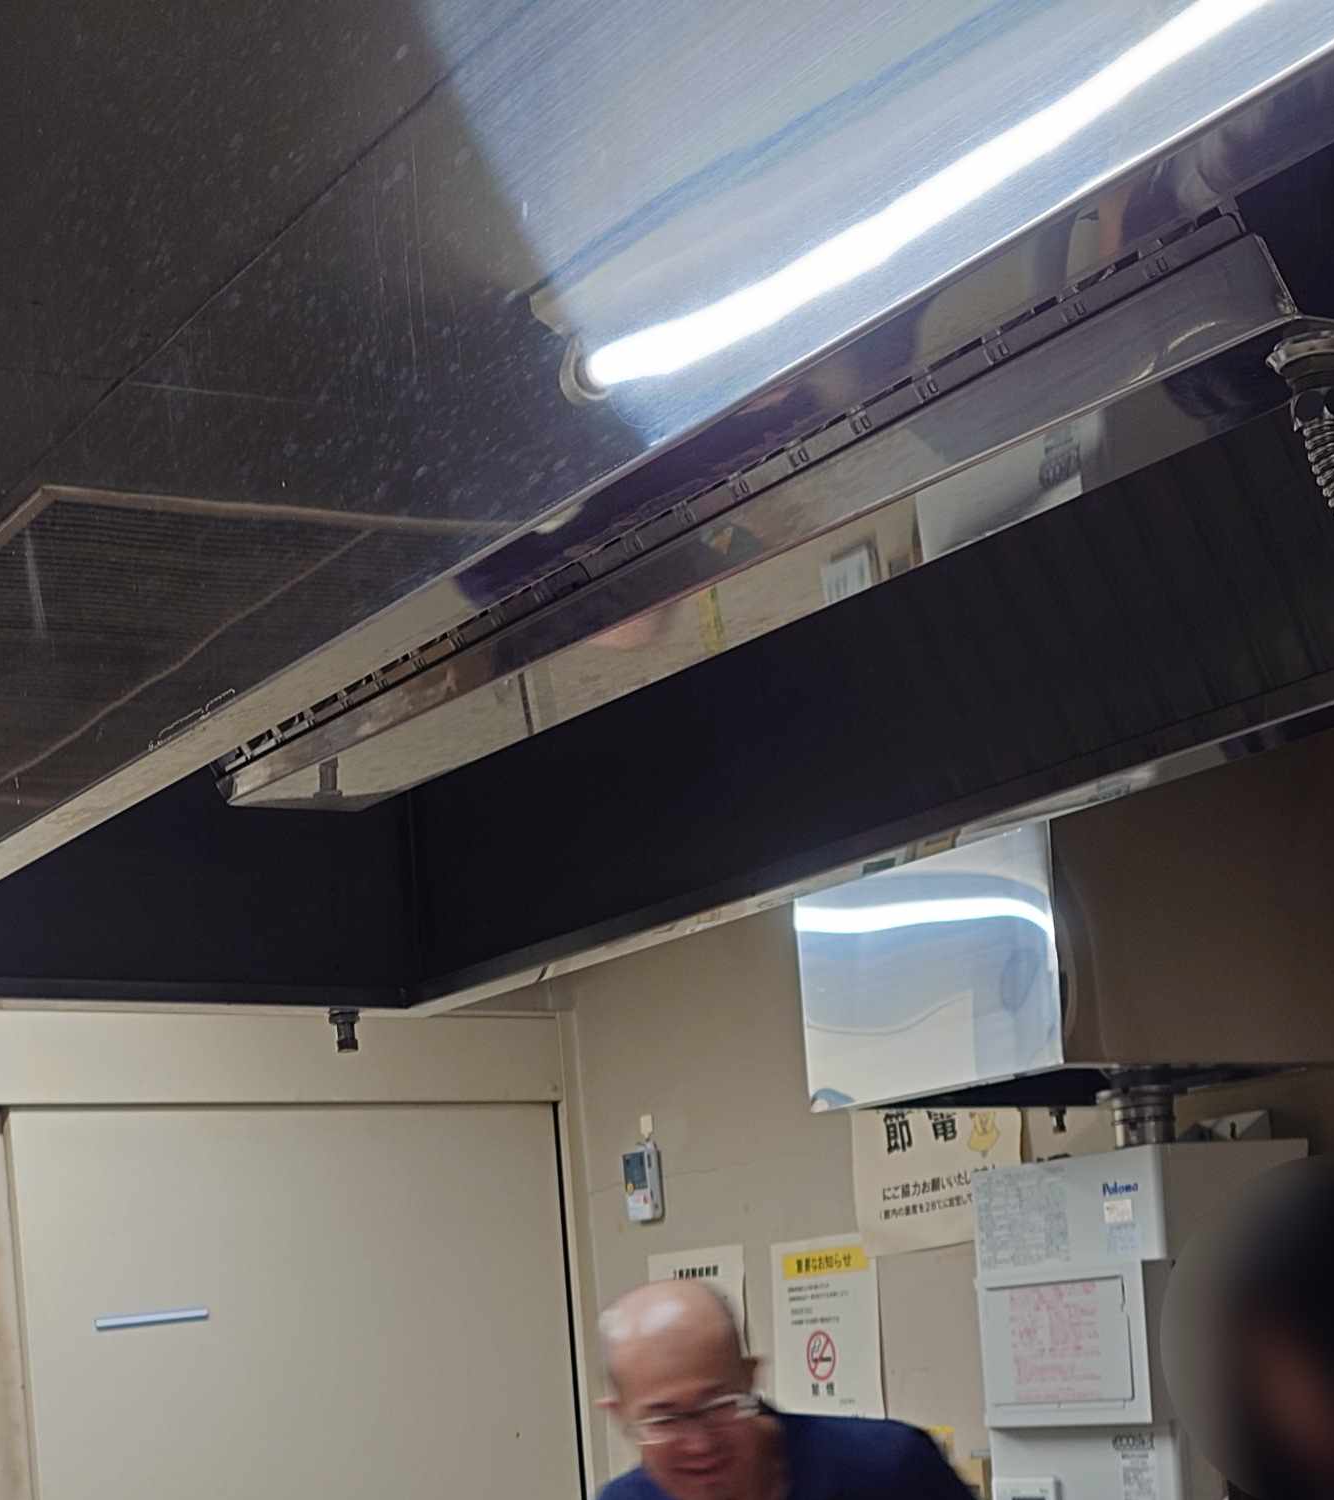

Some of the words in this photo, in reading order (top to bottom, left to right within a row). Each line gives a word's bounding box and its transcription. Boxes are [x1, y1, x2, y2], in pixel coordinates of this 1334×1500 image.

[881, 1166, 989, 1201] にご協力お願いいたし
[1101, 1181, 1139, 1196] Paloma
